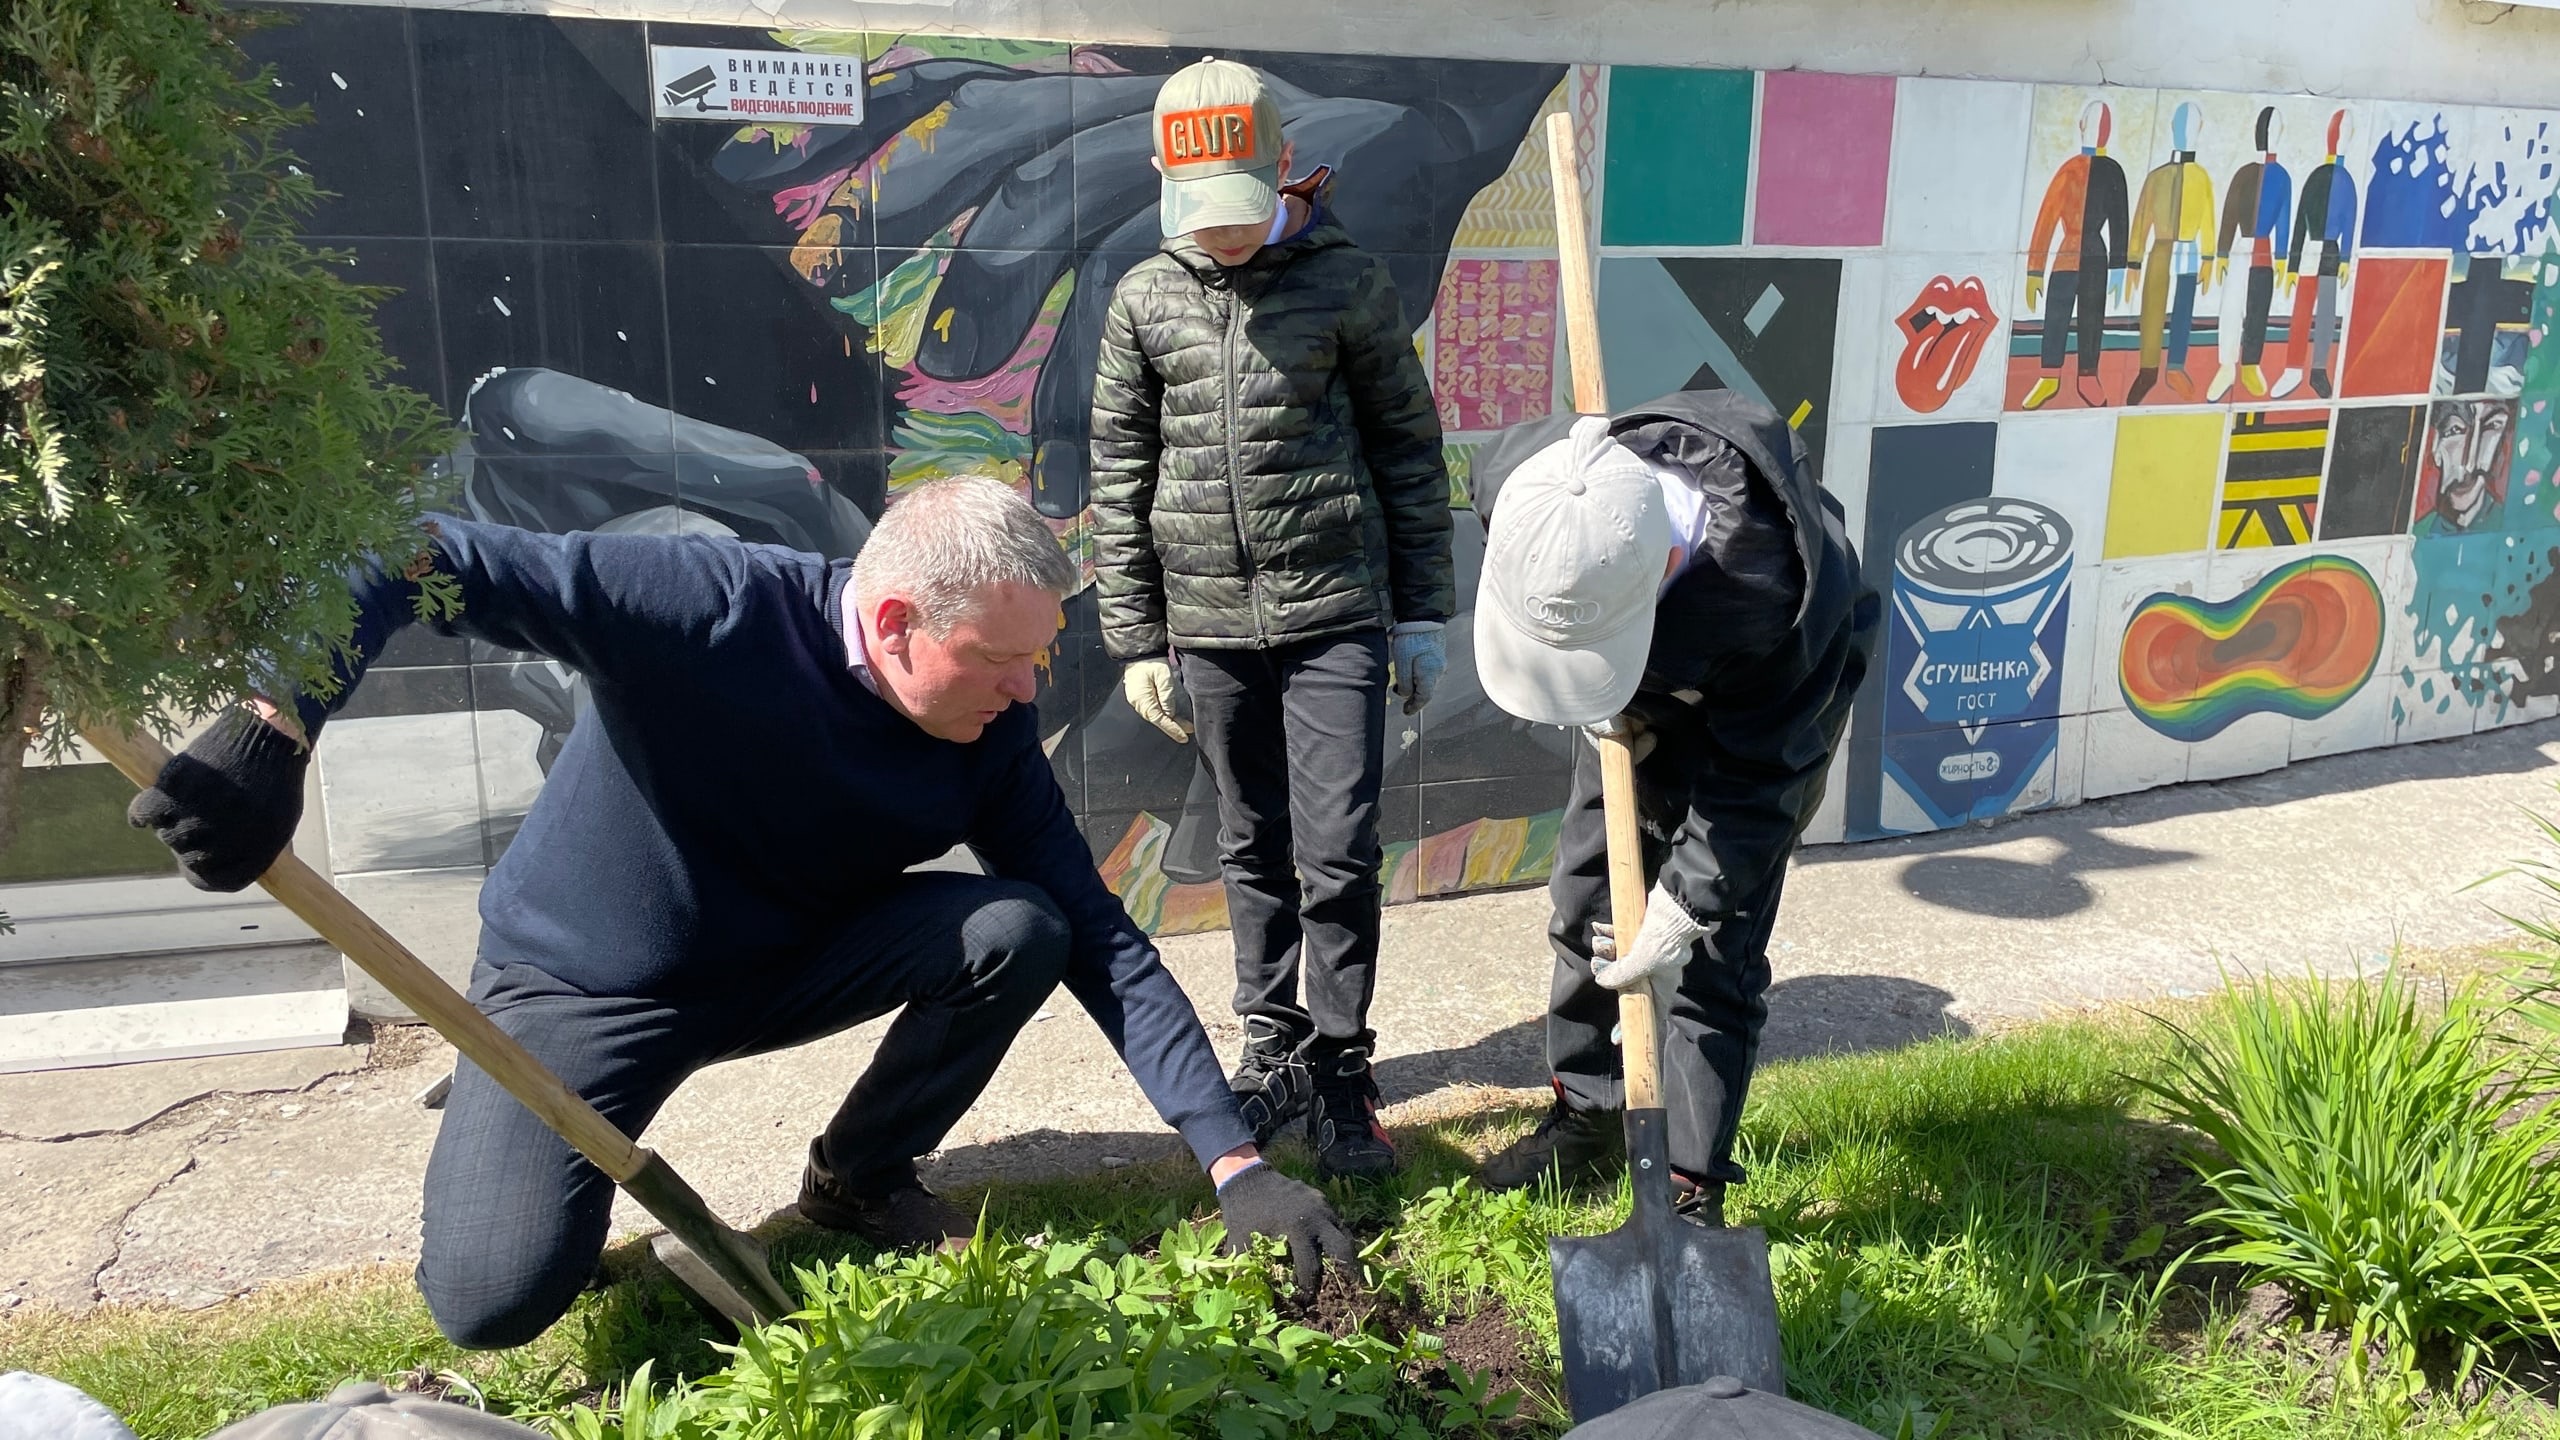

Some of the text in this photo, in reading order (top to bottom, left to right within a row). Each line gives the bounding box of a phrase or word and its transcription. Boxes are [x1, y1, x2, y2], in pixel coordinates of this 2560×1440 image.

[728, 59, 852, 77] ВНИМАНИЕ!
[729, 78, 853, 97] ВЕДЁТСЯ
[731, 98, 854, 117] ВИДЕОНАБЛЮДЕНИЕ
[1922, 660, 2029, 686] СГУЩЕНКА
[1957, 692, 1997, 711] ГОСТ
